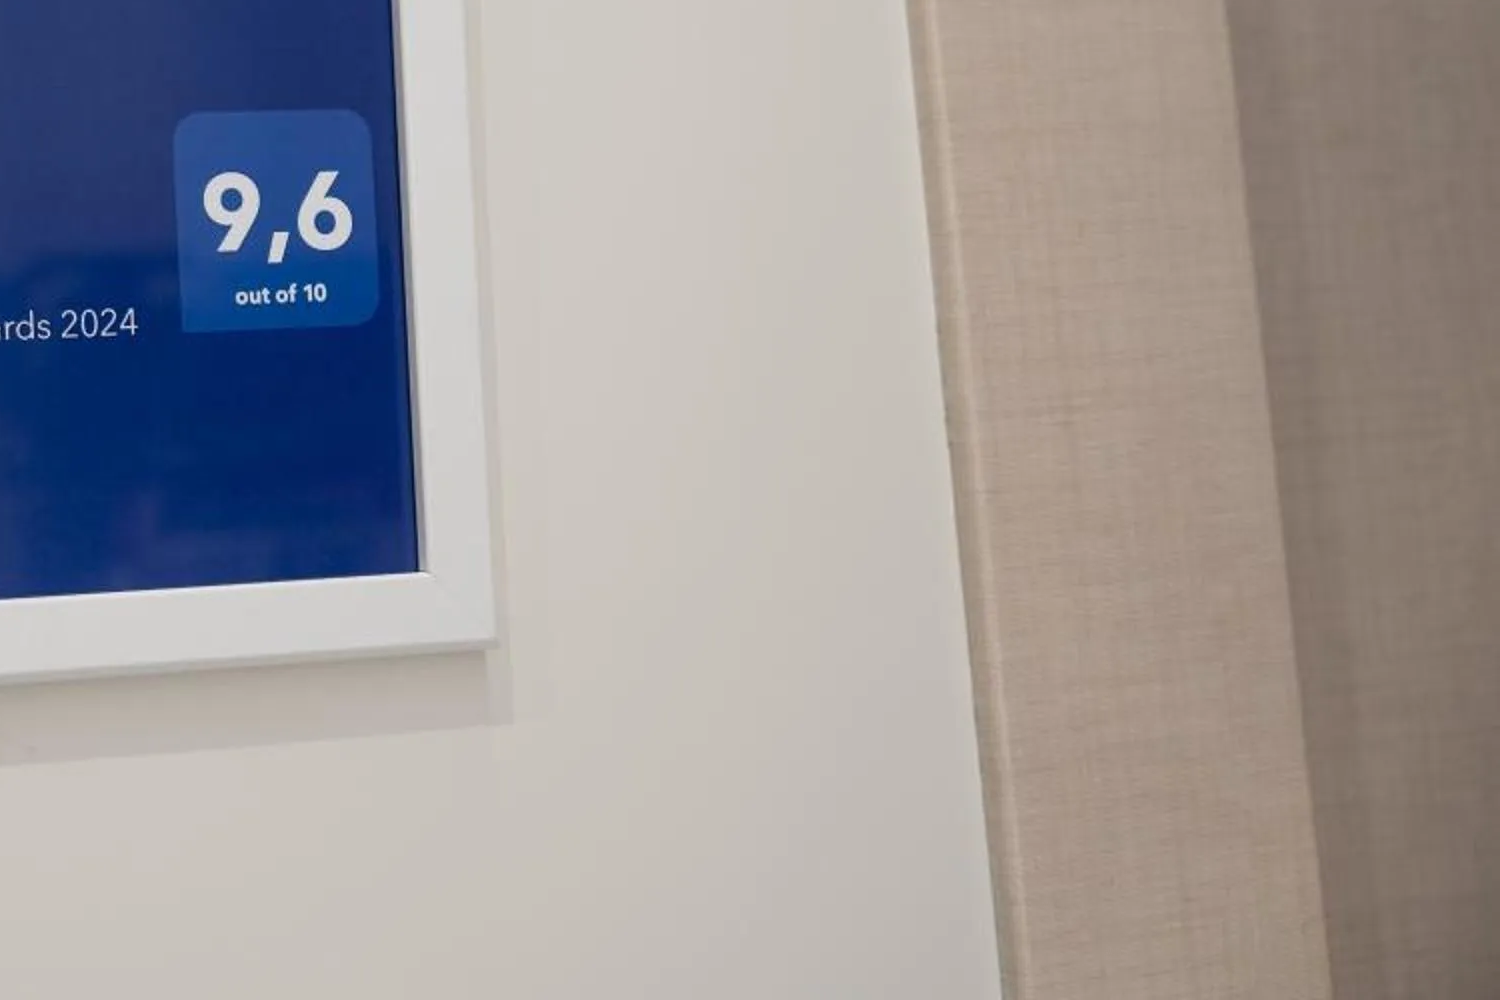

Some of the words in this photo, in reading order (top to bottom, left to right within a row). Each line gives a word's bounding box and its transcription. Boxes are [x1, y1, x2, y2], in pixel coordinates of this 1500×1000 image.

[203, 169, 353, 264] 9,6
[235, 286, 271, 306] out
[275, 283, 298, 303] of
[303, 283, 327, 303] 10
[61, 307, 138, 340] 2024
